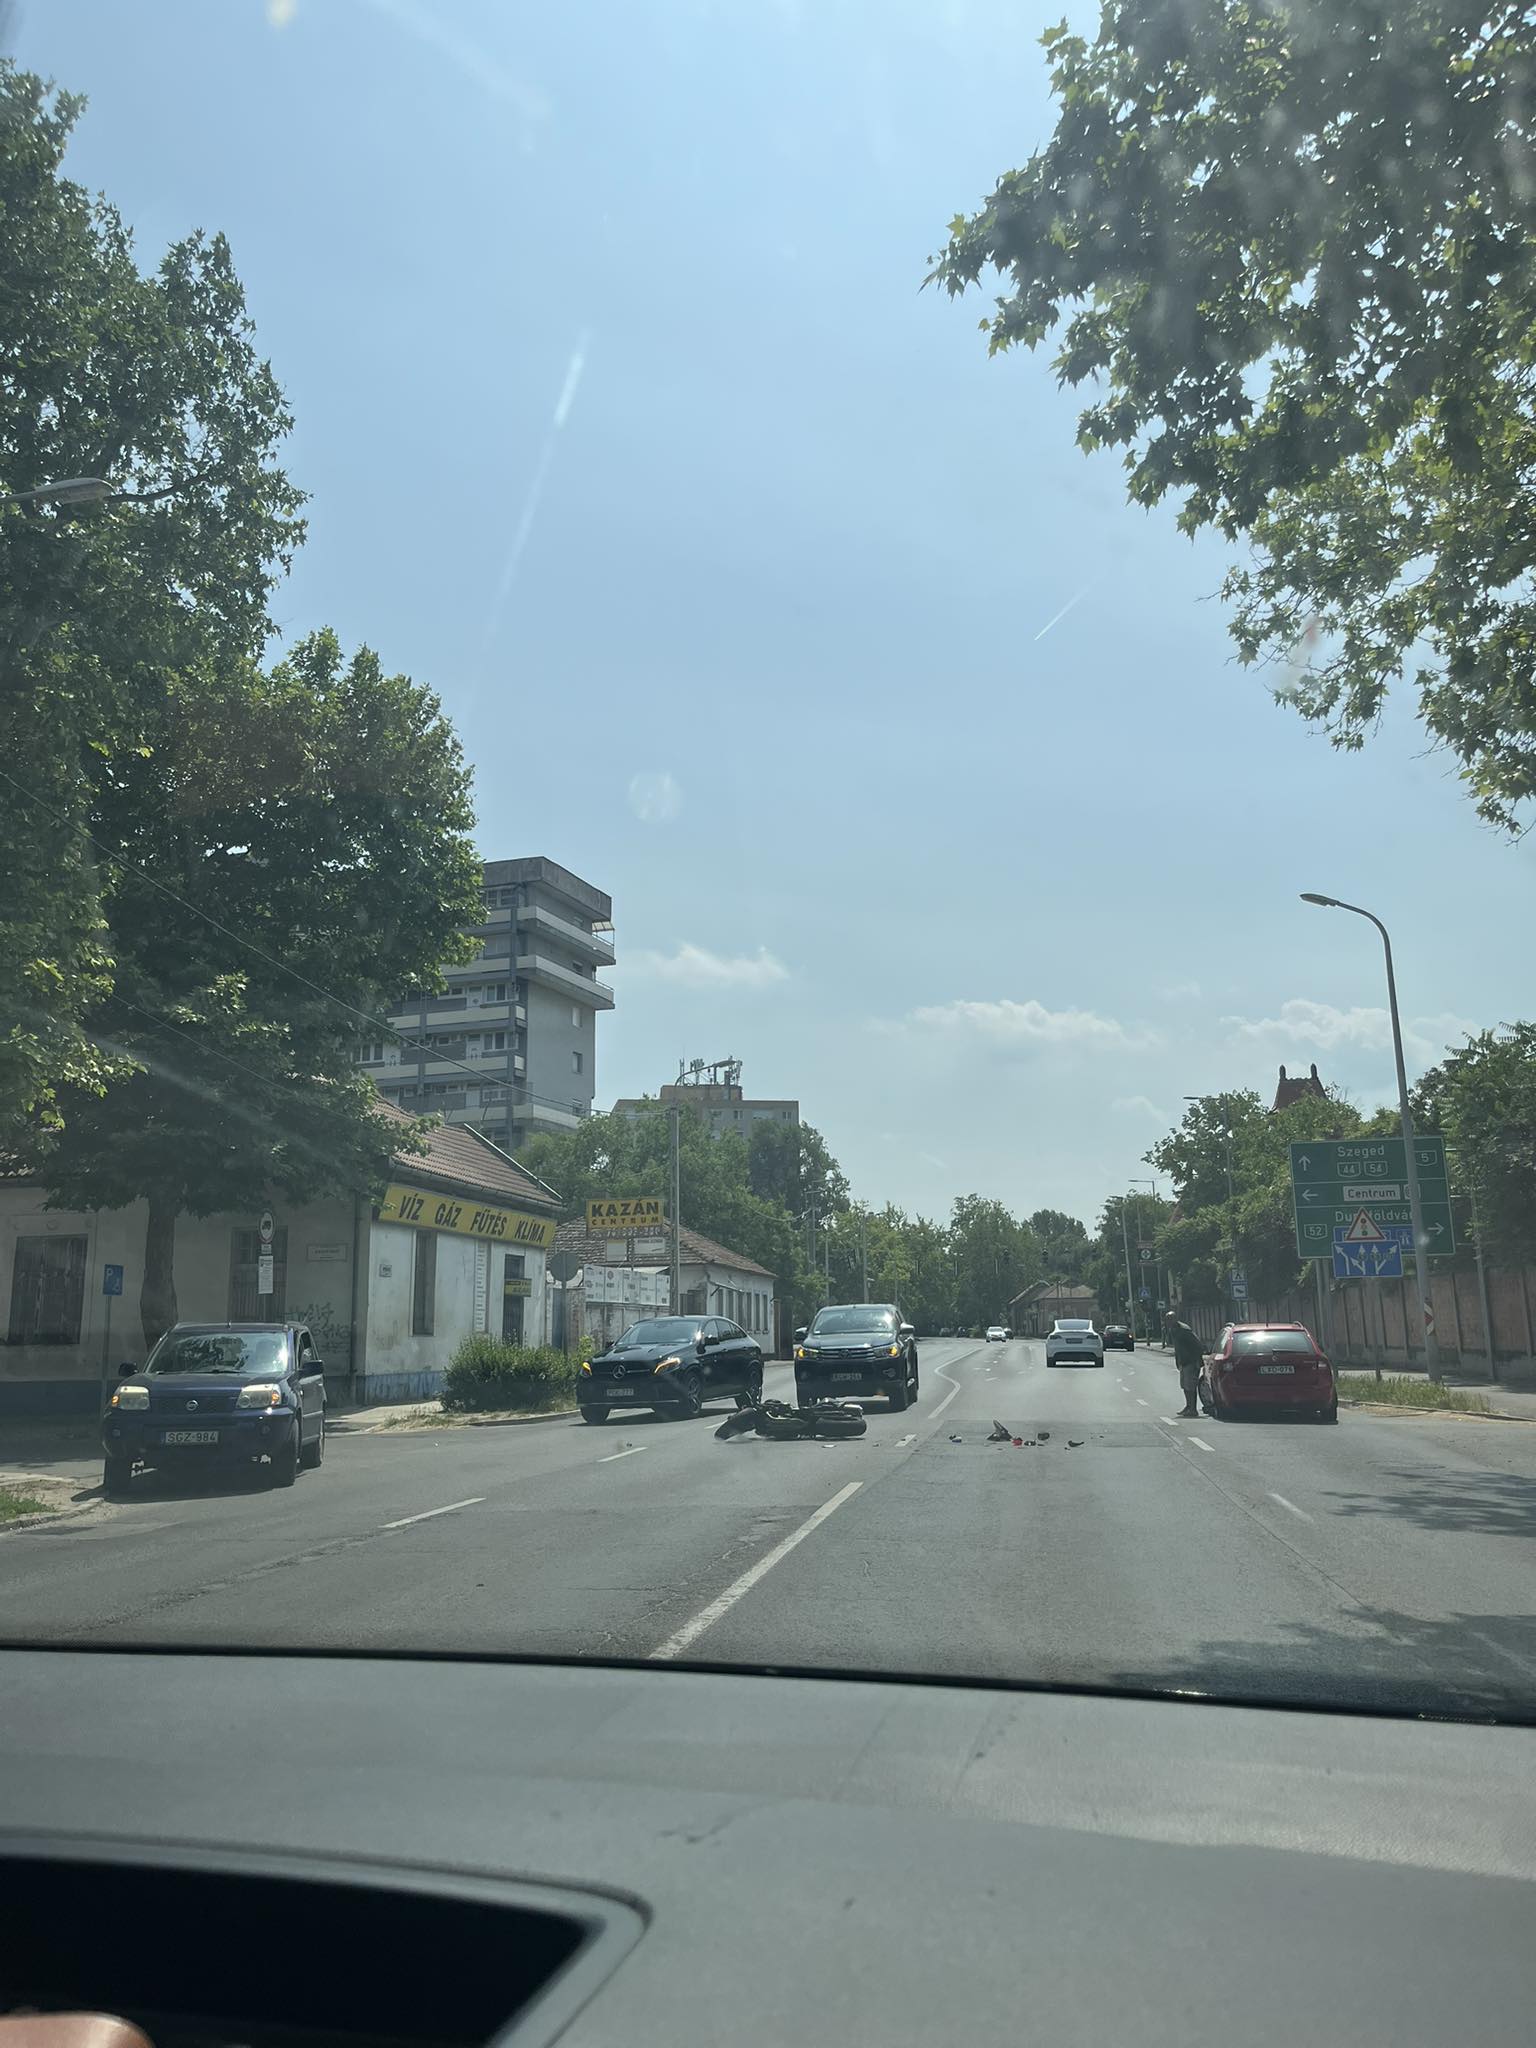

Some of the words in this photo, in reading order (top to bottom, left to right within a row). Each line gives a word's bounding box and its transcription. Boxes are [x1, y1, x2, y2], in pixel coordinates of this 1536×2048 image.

[1337, 1144, 1385, 1159] Szeged
[1421, 1153, 1429, 1163] 5
[1343, 1164, 1355, 1174] 44
[1369, 1163, 1382, 1173] 54
[1347, 1188, 1396, 1199] Centrum
[398, 1193, 424, 1221] VÍZ
[434, 1201, 462, 1228] GÁZ
[470, 1209, 507, 1236] FŰTÉS
[514, 1219, 546, 1243] KLÍMA
[591, 1216, 659, 1226] CENTRUM
[1309, 1227, 1322, 1237] 52
[167, 1432, 217, 1442] SGZ-984
